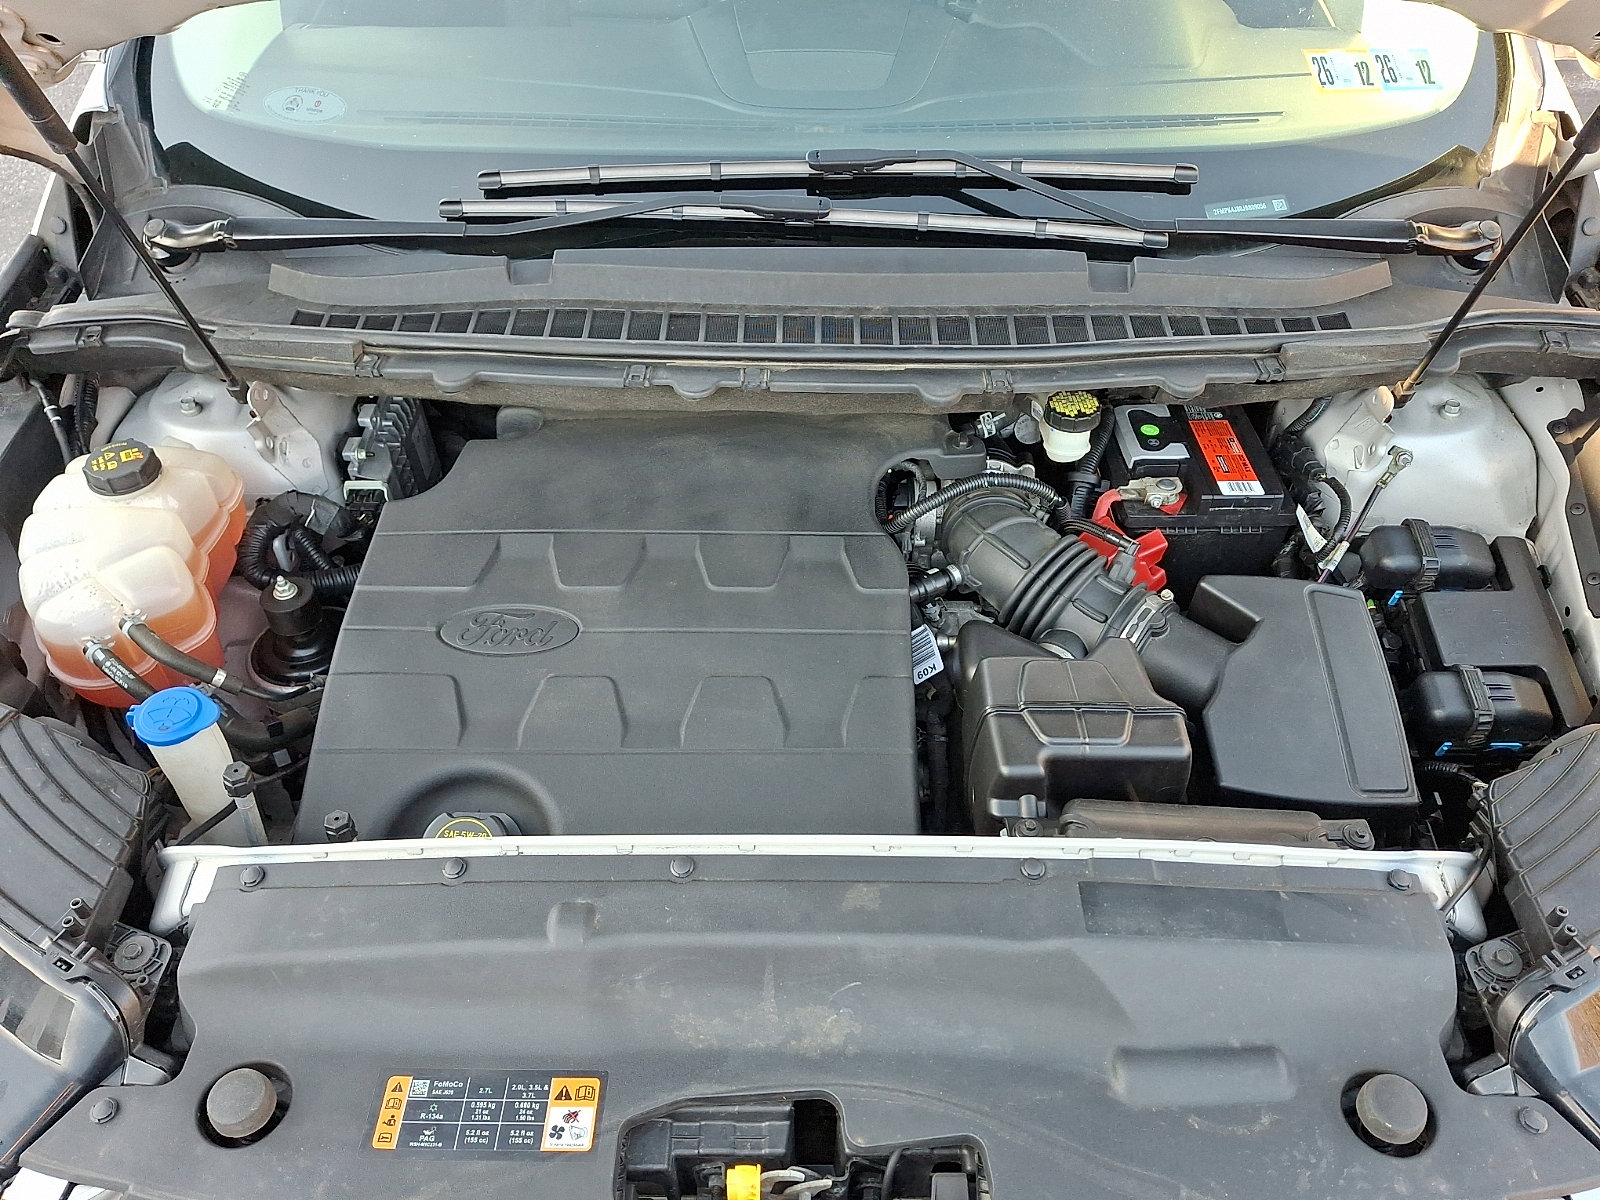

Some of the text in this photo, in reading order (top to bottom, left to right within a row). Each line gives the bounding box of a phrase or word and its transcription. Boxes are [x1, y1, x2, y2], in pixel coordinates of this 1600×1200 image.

[1311, 56, 1375, 86] 26 12
[1374, 54, 1436, 85] 26 12
[457, 610, 558, 647] Ford
[917, 663, 937, 680] K09
[433, 1080, 464, 1088] FoMoCo
[488, 1101, 496, 1110] kg
[532, 1101, 540, 1110] kg
[419, 1112, 444, 1120] R-134a
